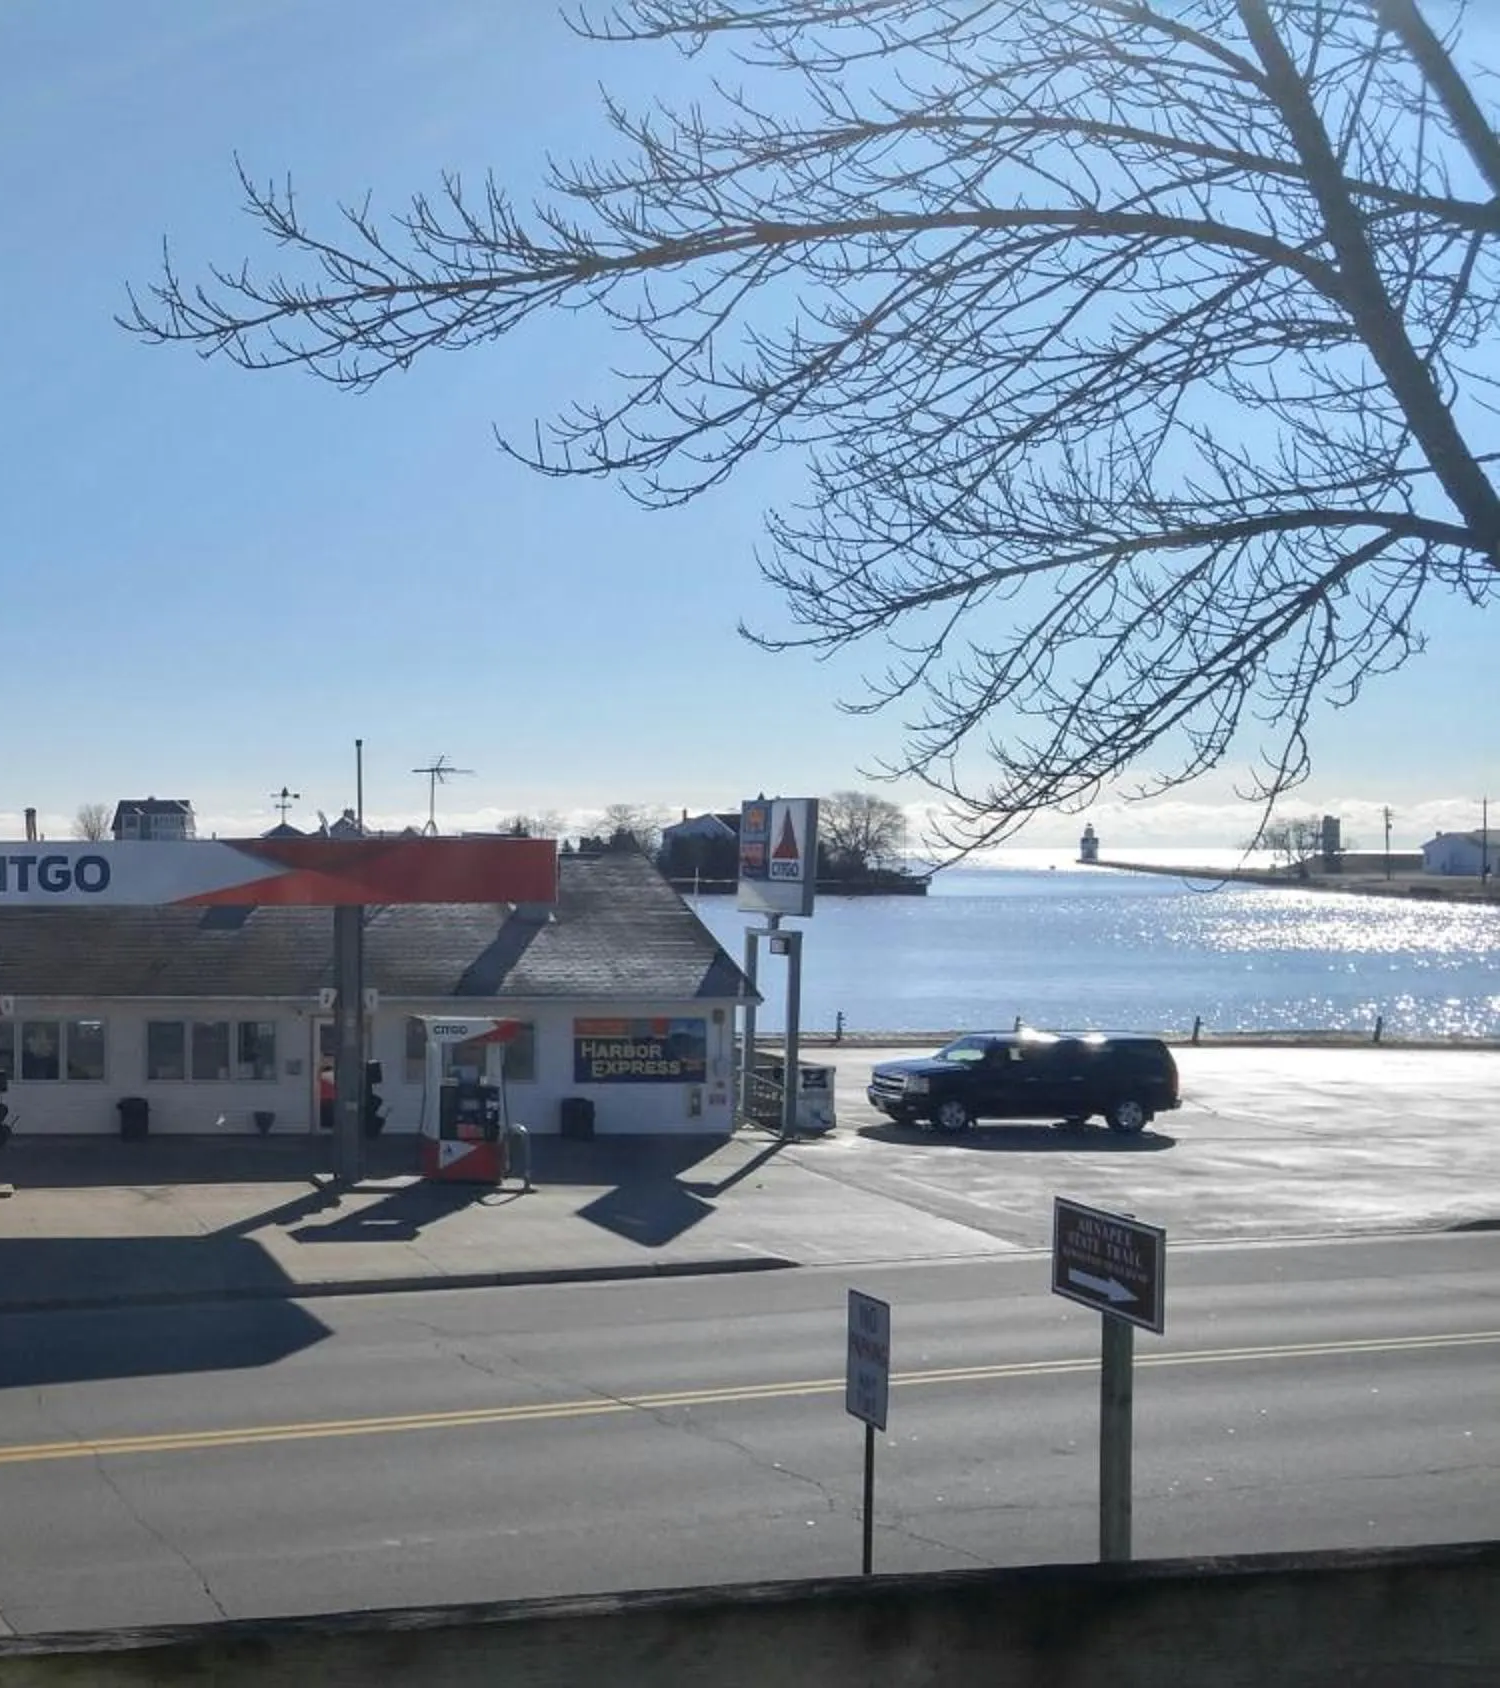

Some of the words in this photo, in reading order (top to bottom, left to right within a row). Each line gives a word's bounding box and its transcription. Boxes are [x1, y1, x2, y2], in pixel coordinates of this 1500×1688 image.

[771, 861, 799, 877] CITGO
[434, 1024, 469, 1035] CITGO
[580, 1039, 662, 1059] HARBOR
[591, 1059, 681, 1078] EXPRESS
